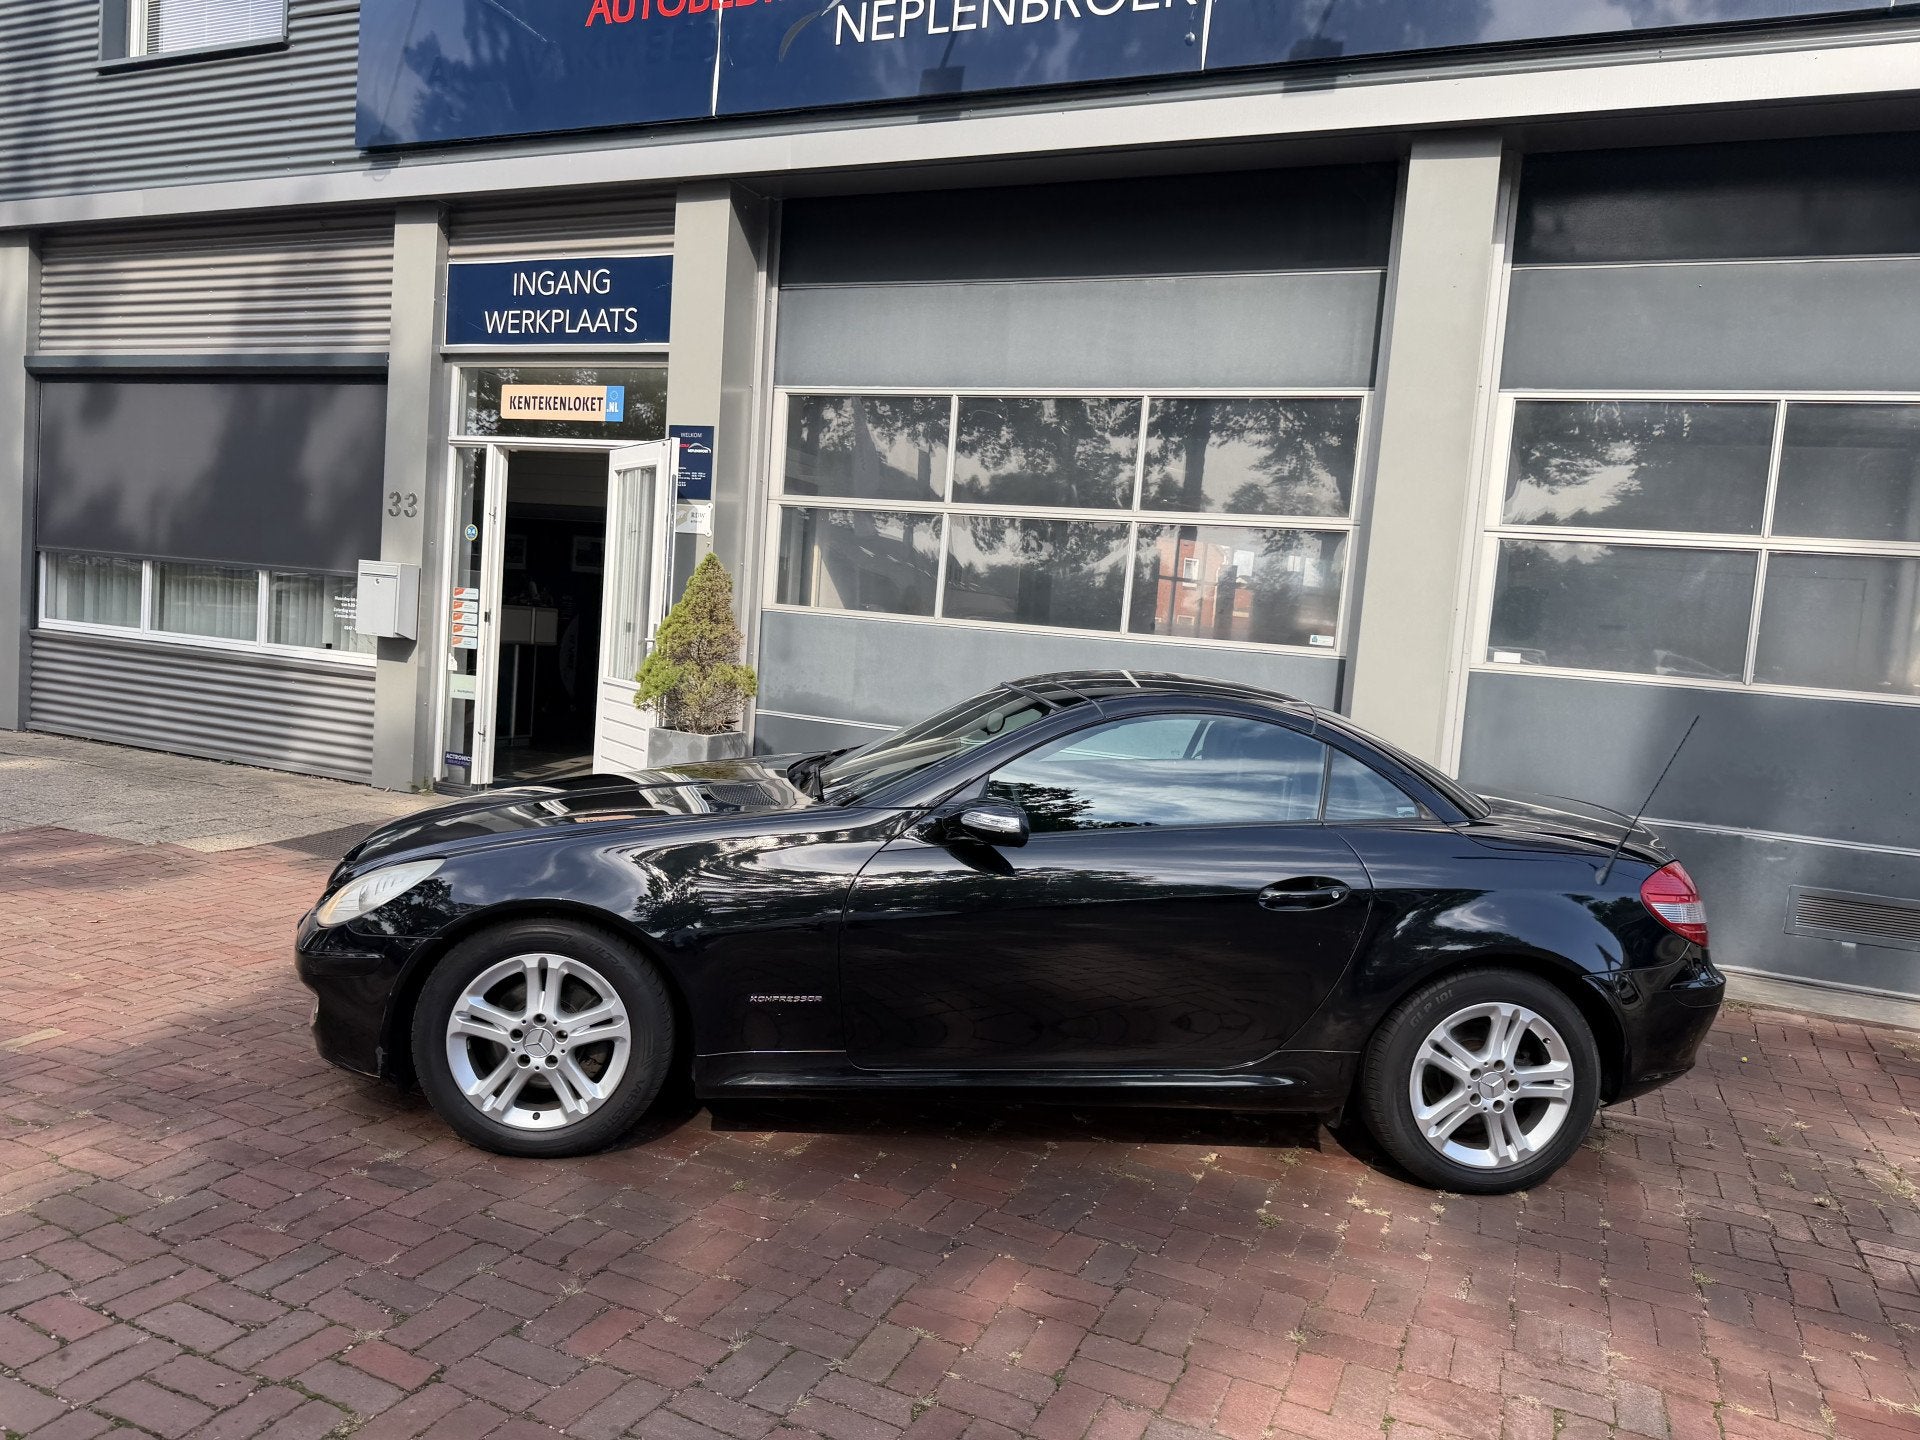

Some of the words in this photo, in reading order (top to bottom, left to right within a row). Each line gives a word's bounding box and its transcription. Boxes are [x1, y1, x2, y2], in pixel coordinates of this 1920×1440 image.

[585, 0, 772, 27] AUTO
[835, 0, 1197, 46] NEPLENB
[513, 268, 611, 296] INGANG
[484, 307, 638, 334] WERKPLAATS
[509, 395, 604, 412] KENTEKENLOKET
[388, 491, 418, 518] 33
